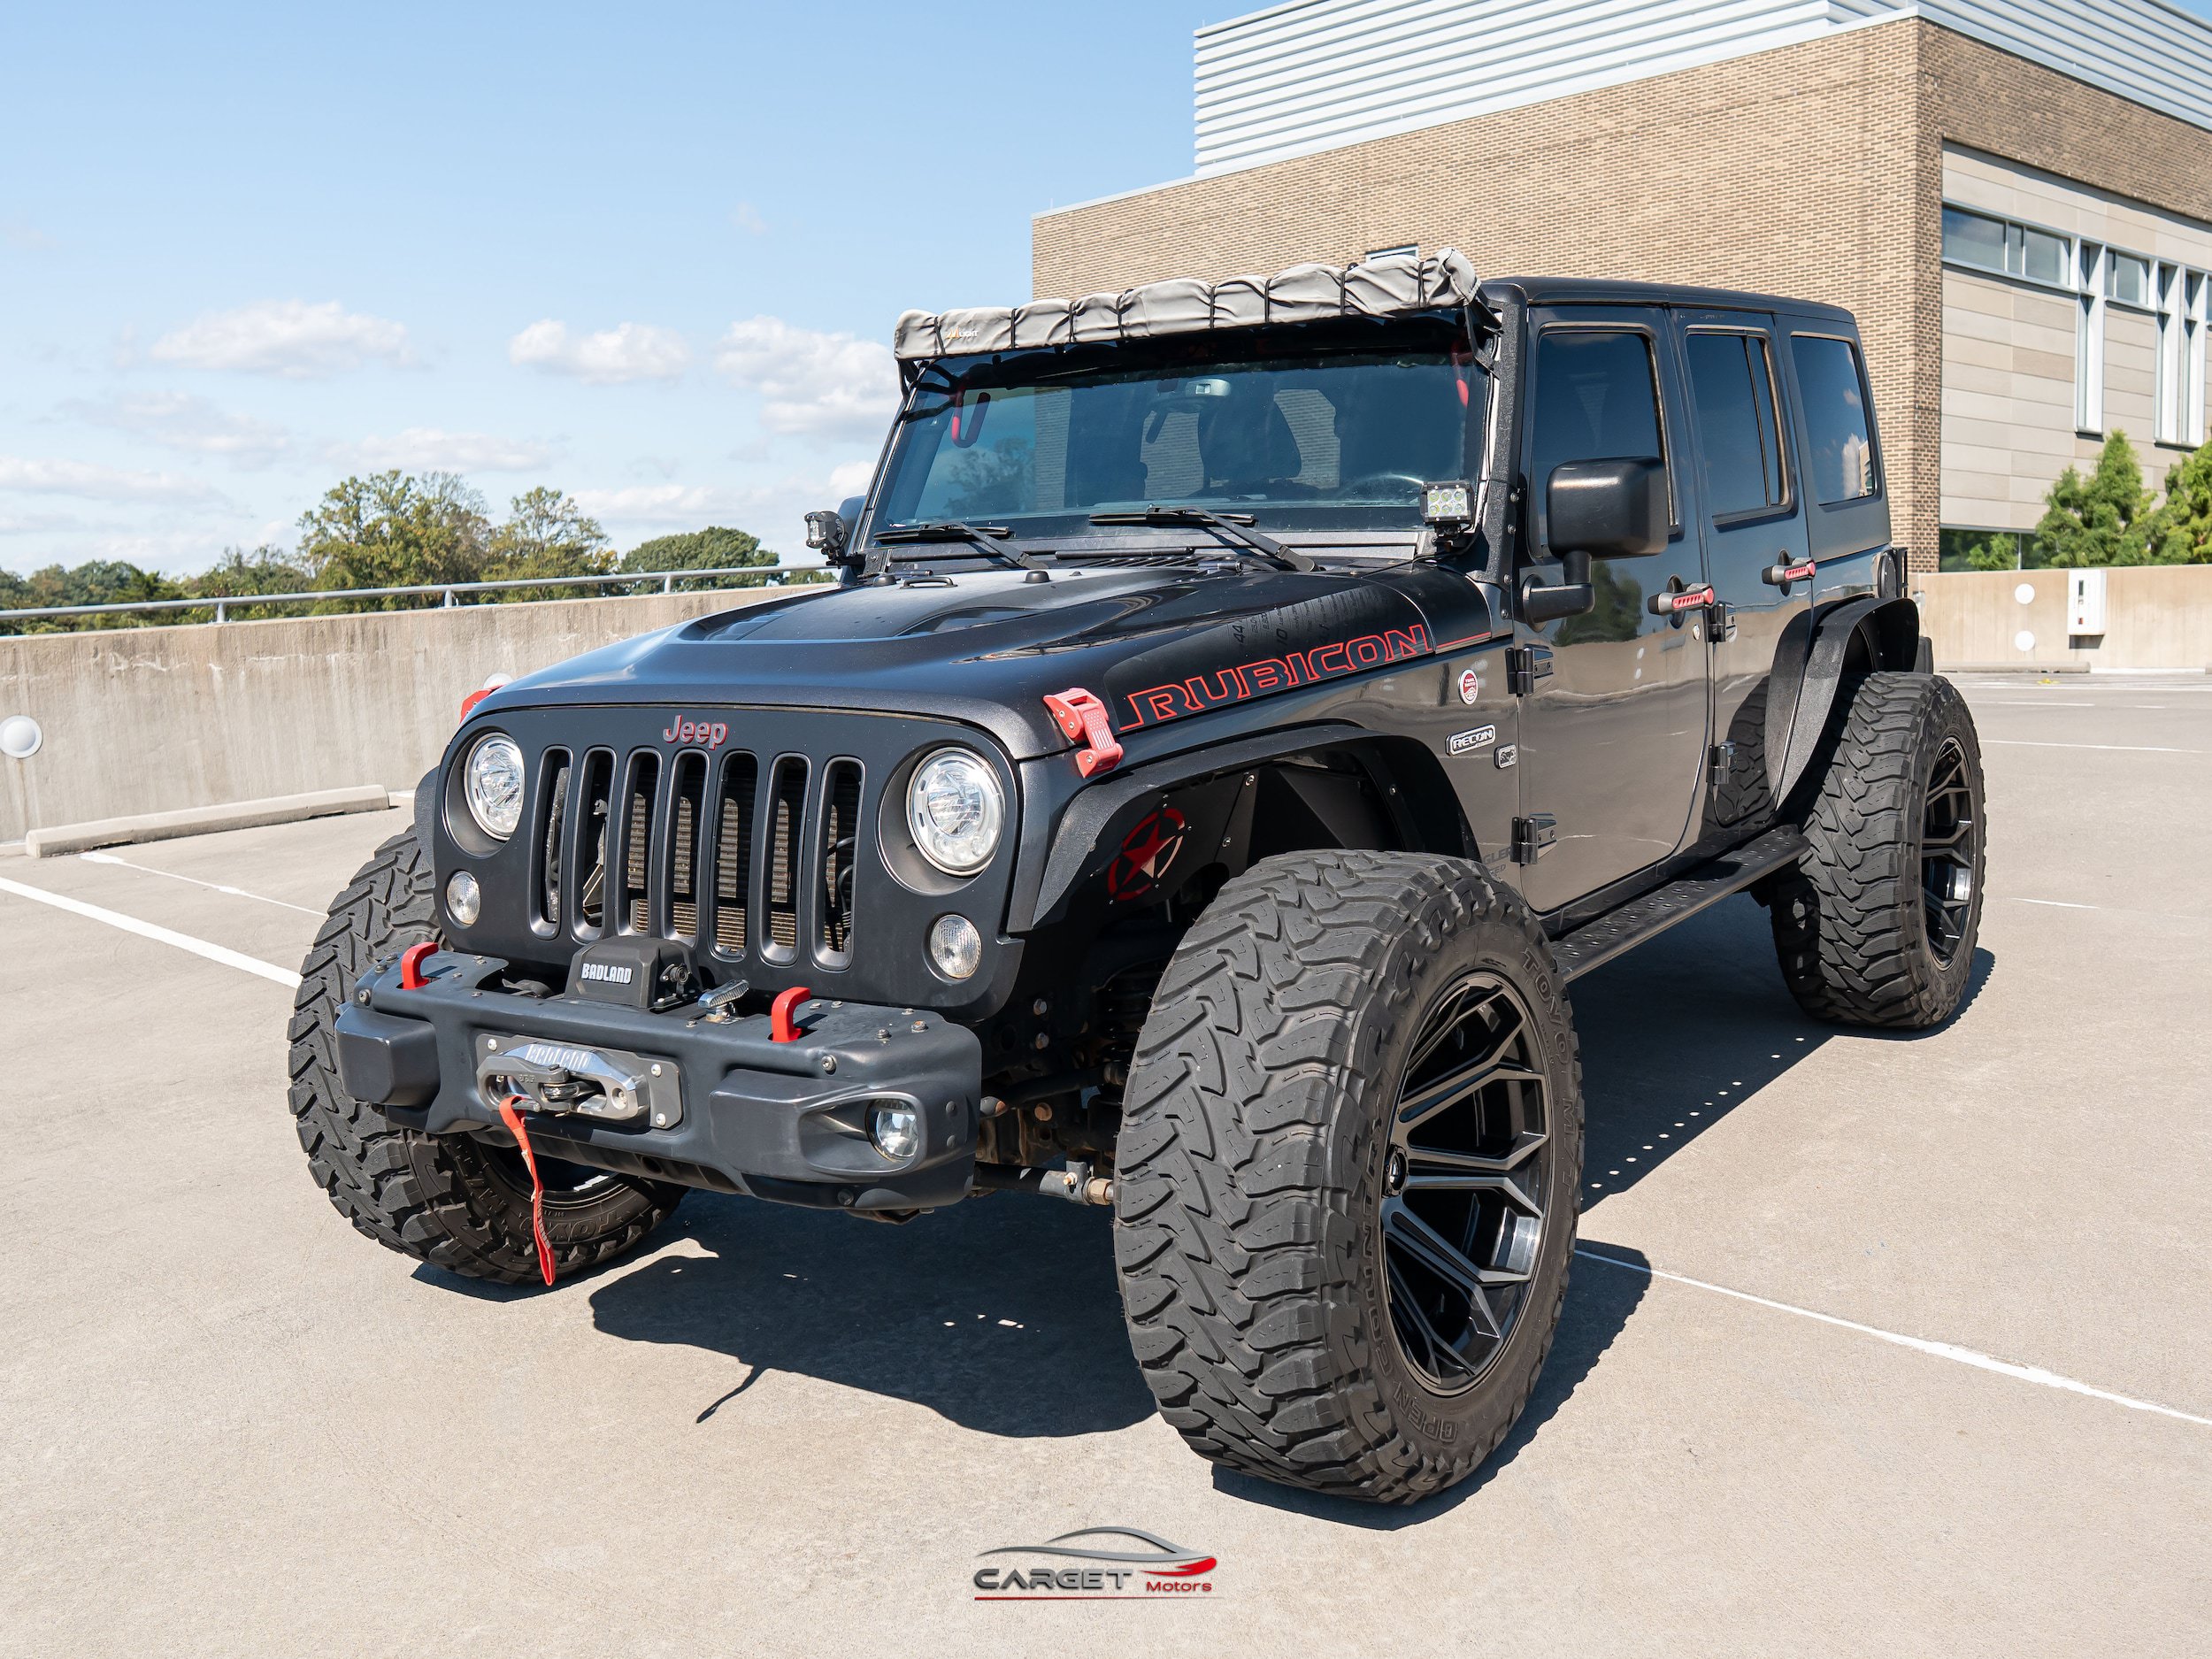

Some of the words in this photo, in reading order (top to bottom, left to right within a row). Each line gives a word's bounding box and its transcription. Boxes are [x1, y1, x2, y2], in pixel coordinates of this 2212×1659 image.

[1119, 624, 1433, 732] RUBICON
[663, 714, 728, 750] Jeep
[1453, 730, 1493, 750] RECON
[581, 963, 633, 984] BADLAND
[1523, 948, 1570, 1064] TOYO
